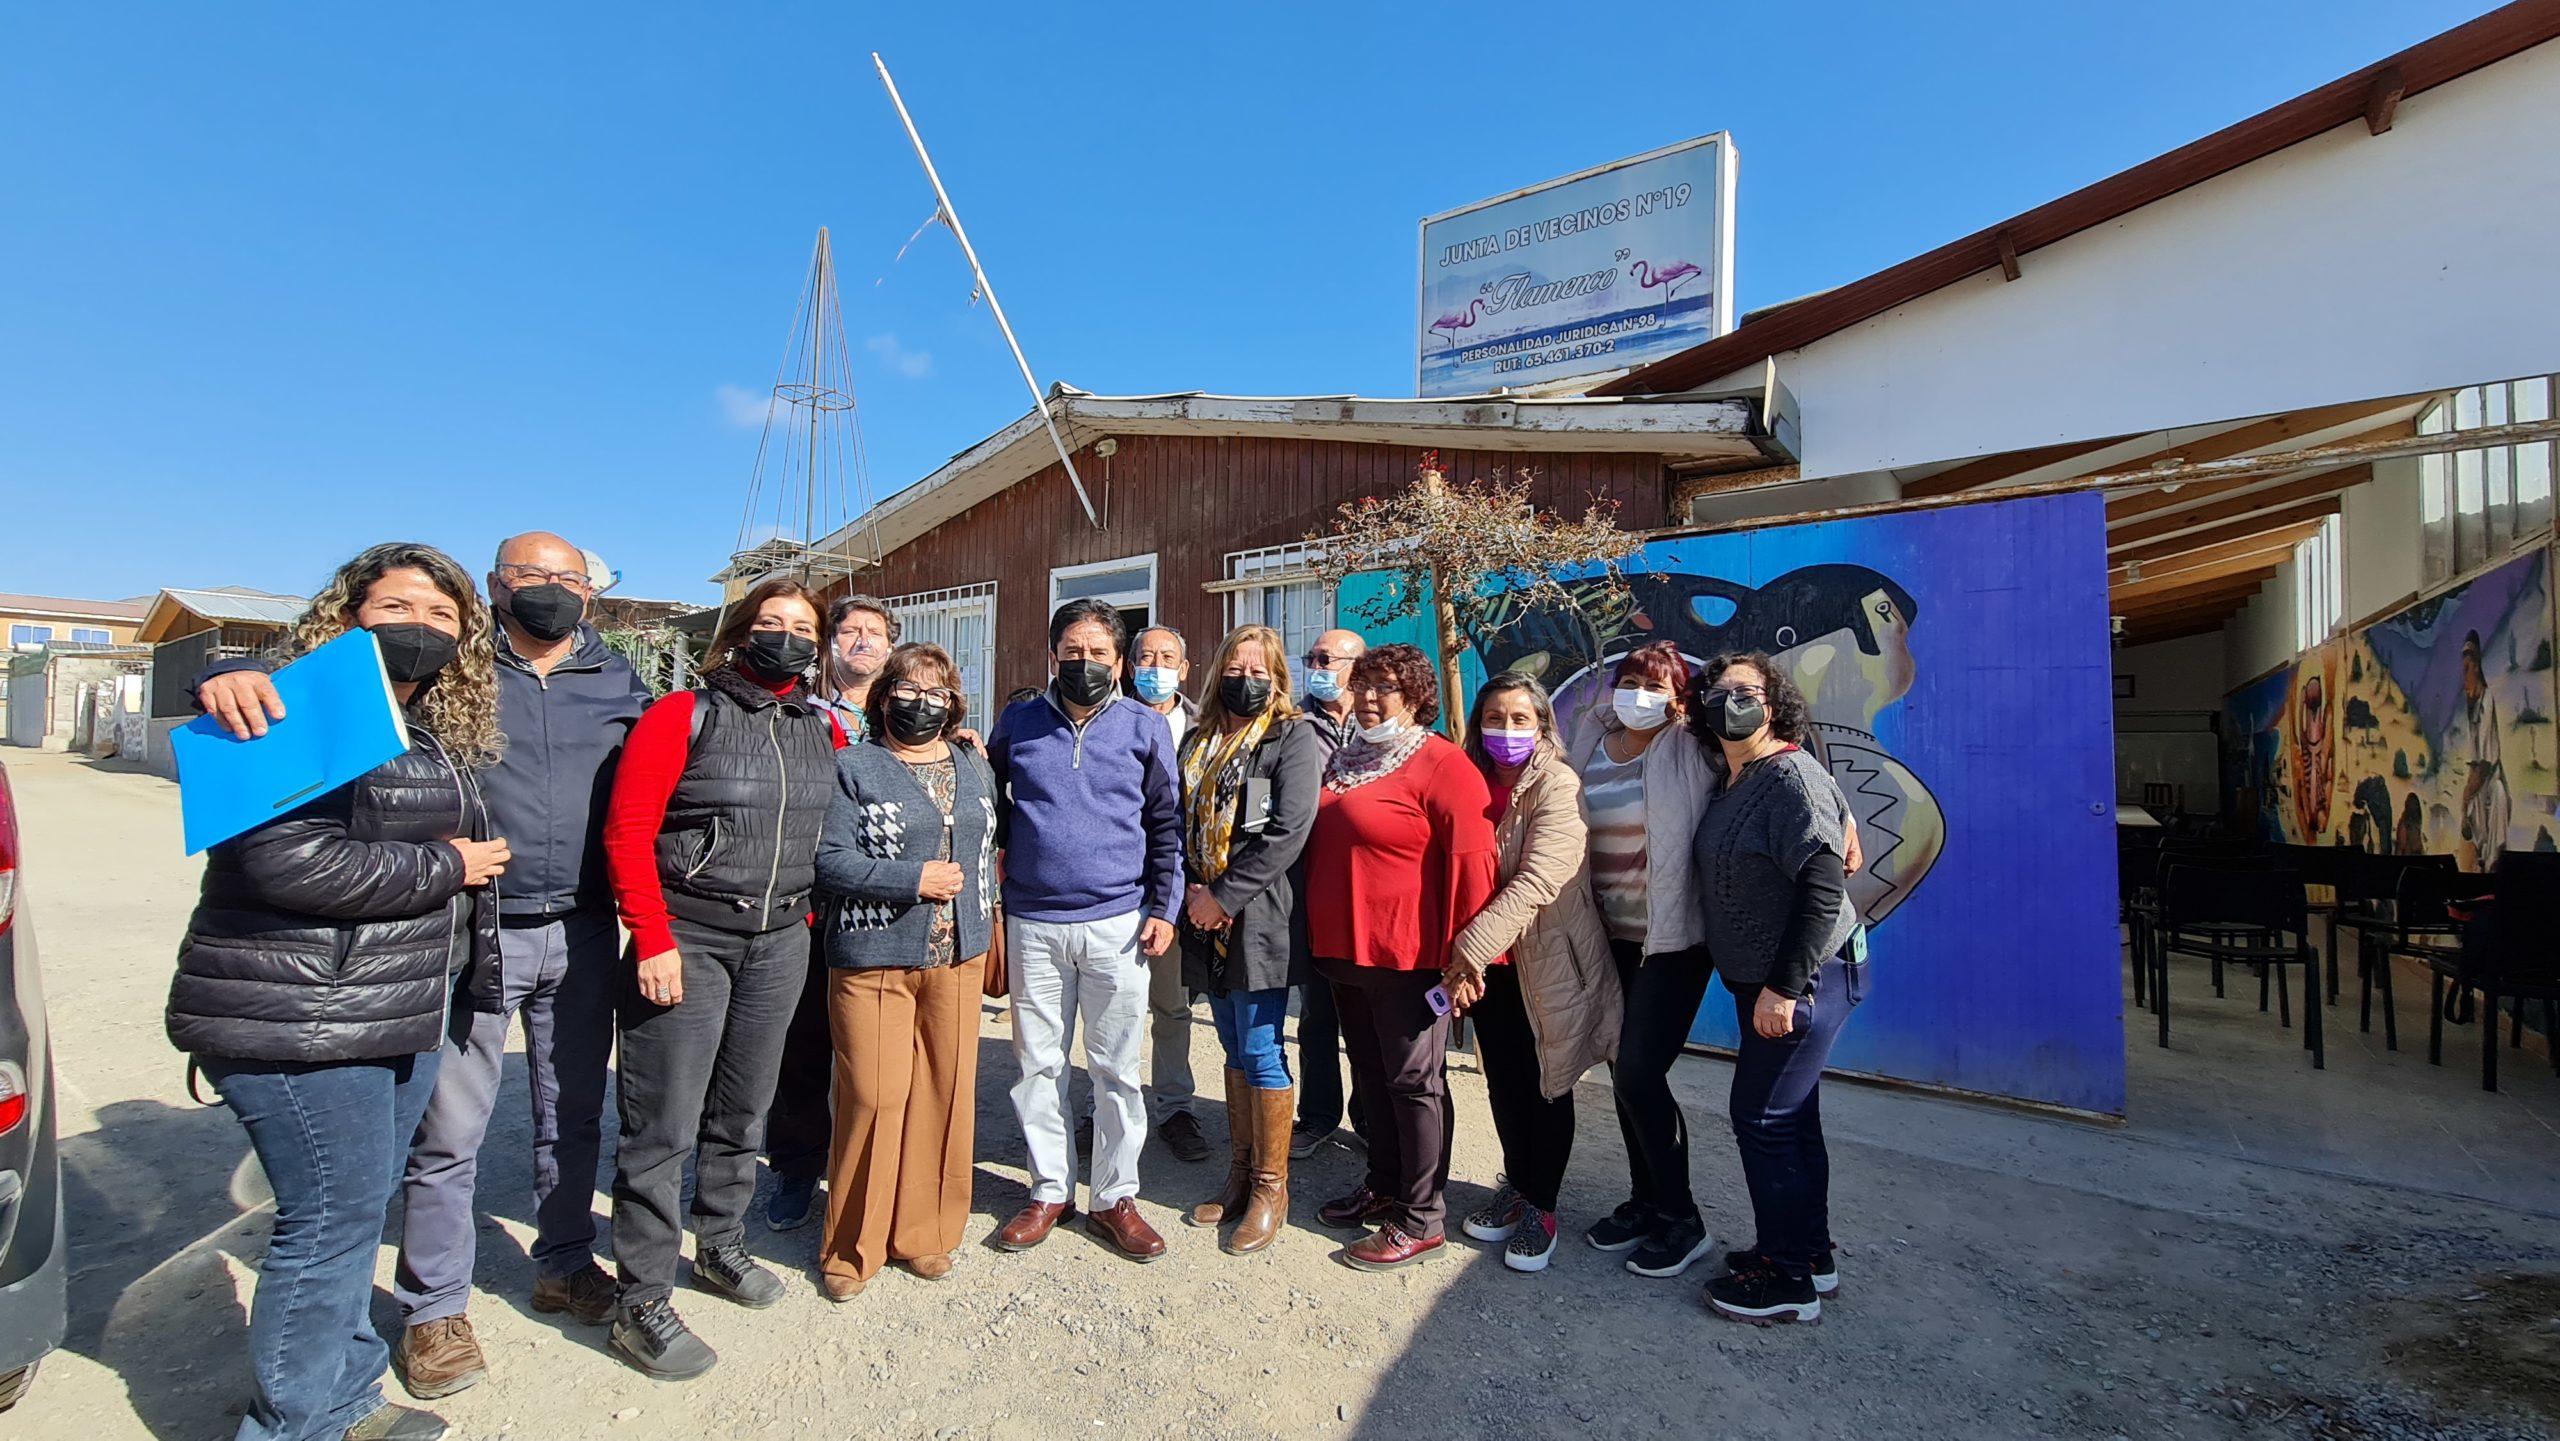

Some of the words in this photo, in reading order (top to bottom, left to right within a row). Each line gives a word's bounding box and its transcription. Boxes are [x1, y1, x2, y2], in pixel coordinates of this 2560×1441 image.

[1440, 236, 1500, 267] JUNTA
[1505, 225, 1531, 251] DE
[1534, 199, 1630, 242] VECINOS
[1461, 334, 1552, 363] PERSONALIDAD
[1555, 322, 1621, 345] JURIDICA
[1494, 358, 1522, 374] RUT:
[1525, 339, 1615, 368] 65.461.370-2
